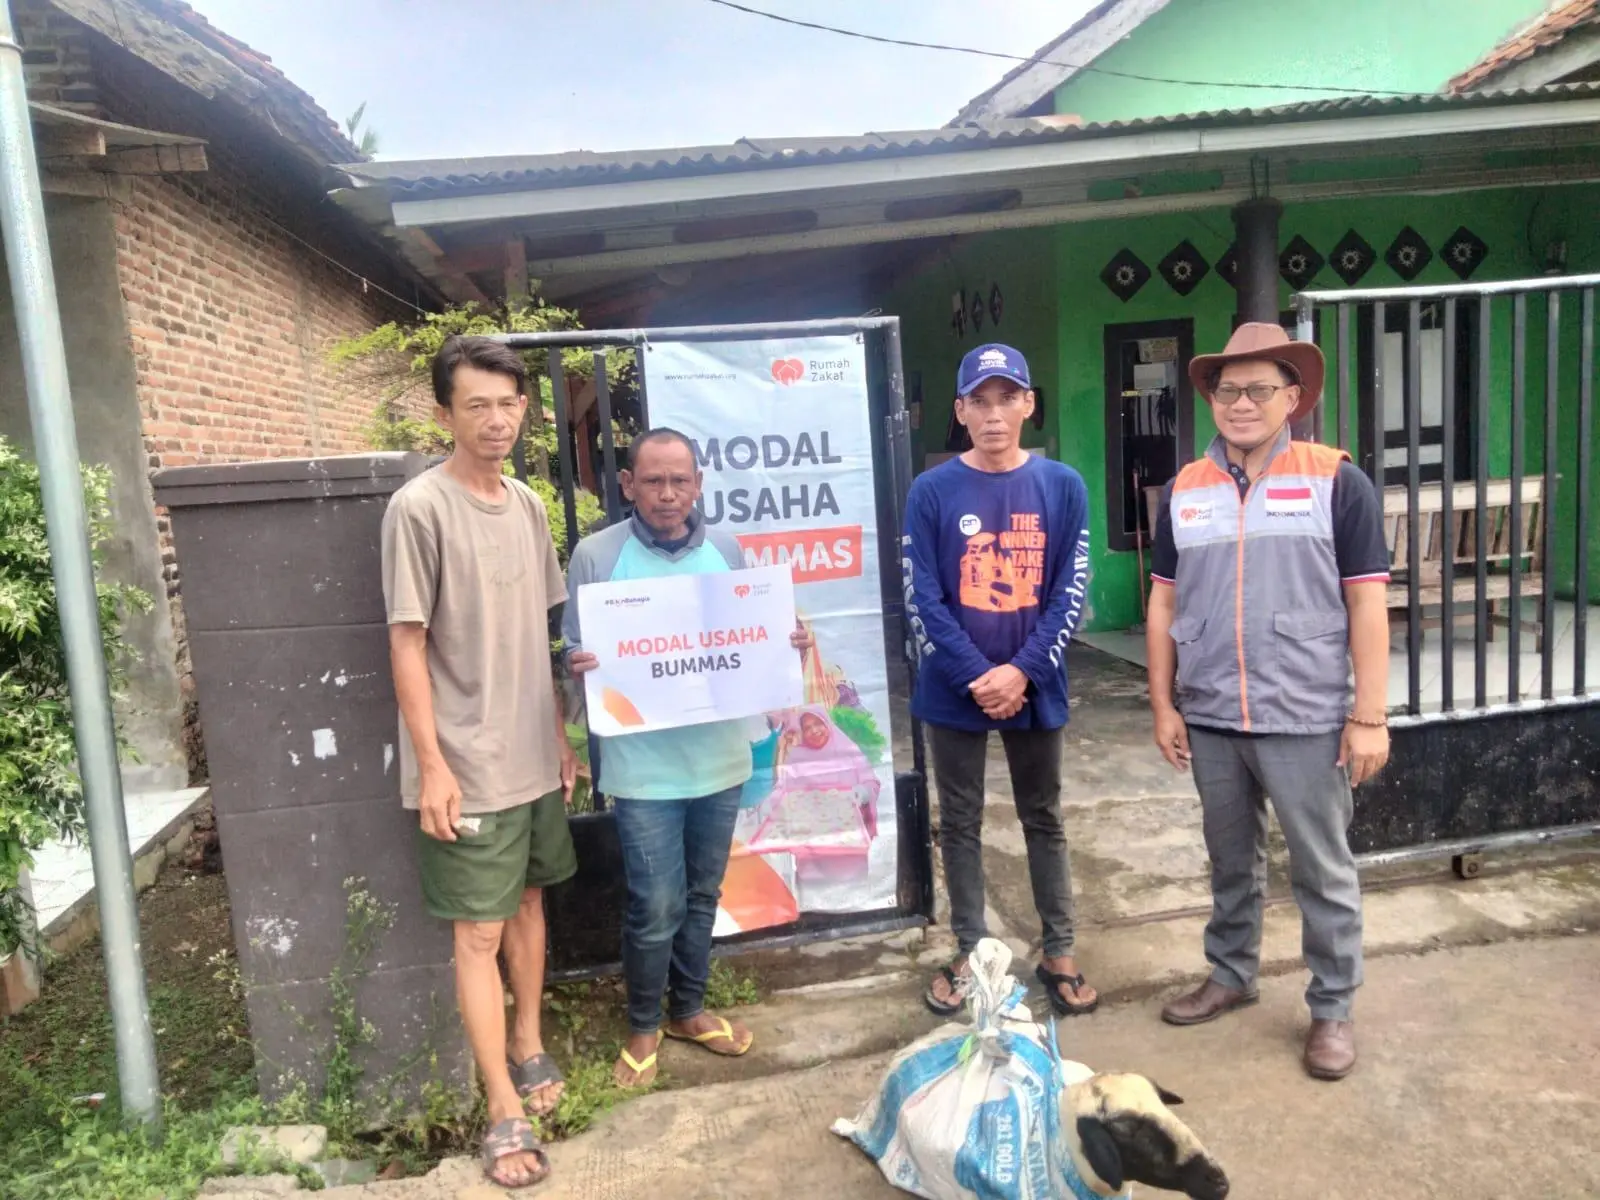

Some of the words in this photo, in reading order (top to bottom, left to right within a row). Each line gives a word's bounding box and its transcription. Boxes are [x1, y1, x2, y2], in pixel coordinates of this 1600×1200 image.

[809, 358, 850, 370] Rumah
[811, 370, 845, 382] Zakat
[690, 431, 842, 471] MODAL
[697, 482, 841, 525] USAHA
[1010, 513, 1040, 530] THE
[743, 538, 853, 572] MMAS
[1010, 550, 1044, 567] TAKE
[617, 633, 694, 658] MODAL
[699, 625, 769, 648] USAHA
[650, 652, 741, 679] BUMMAS
